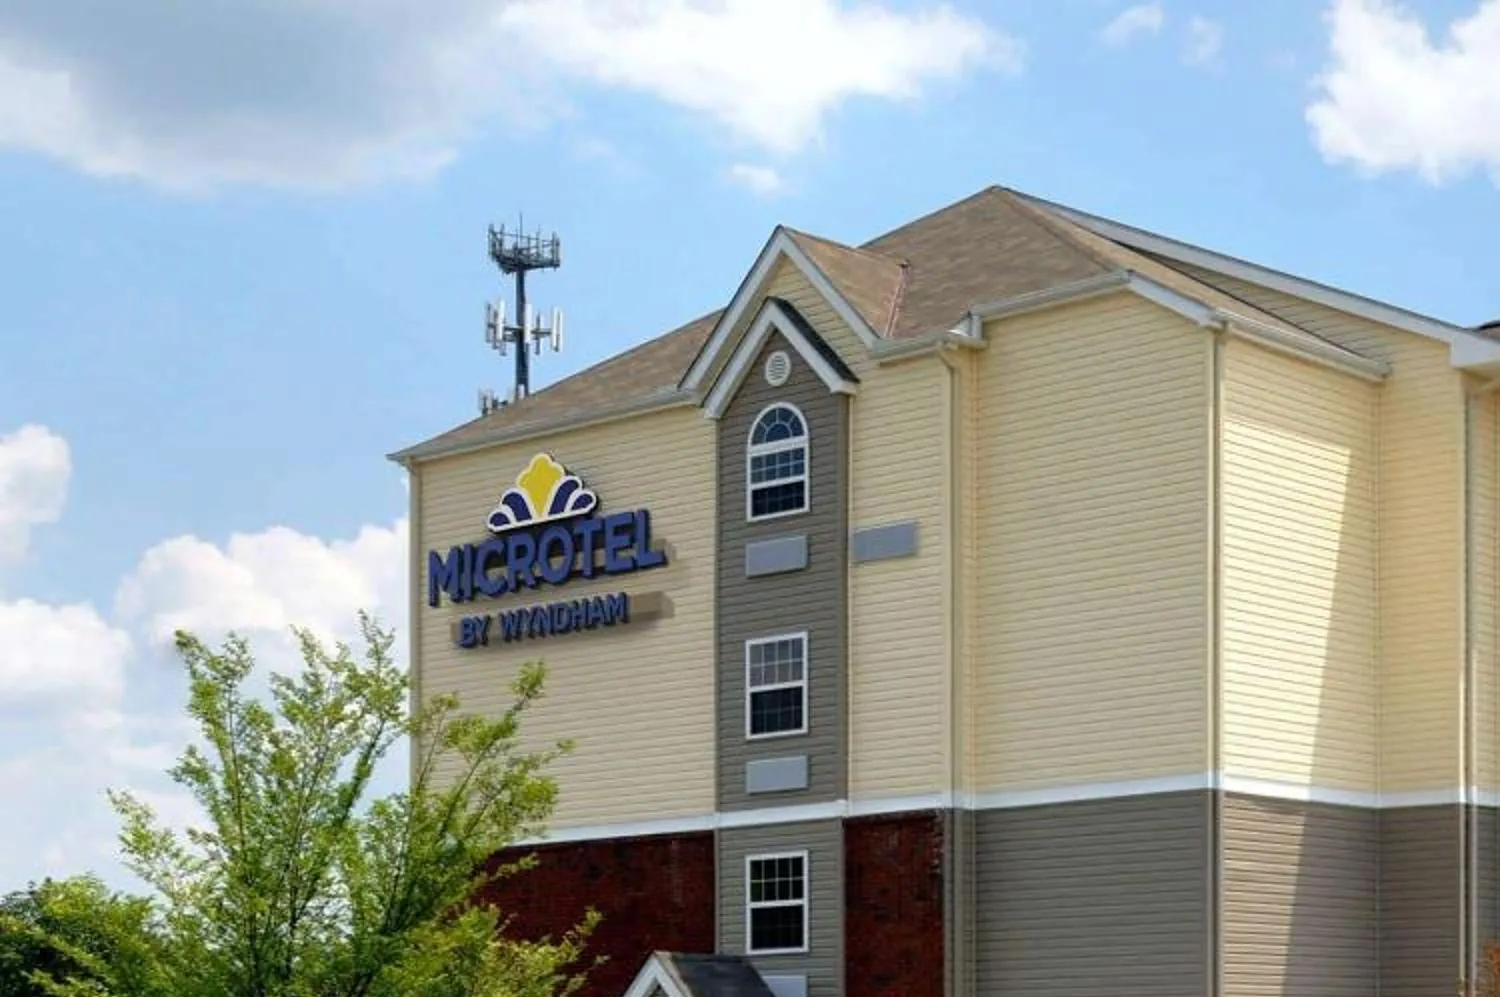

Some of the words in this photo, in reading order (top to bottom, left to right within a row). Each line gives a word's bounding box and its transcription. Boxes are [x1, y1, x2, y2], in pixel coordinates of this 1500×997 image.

[429, 509, 667, 607] MICROTEL
[458, 615, 490, 648] BY
[500, 592, 630, 642] WYNDHAM
